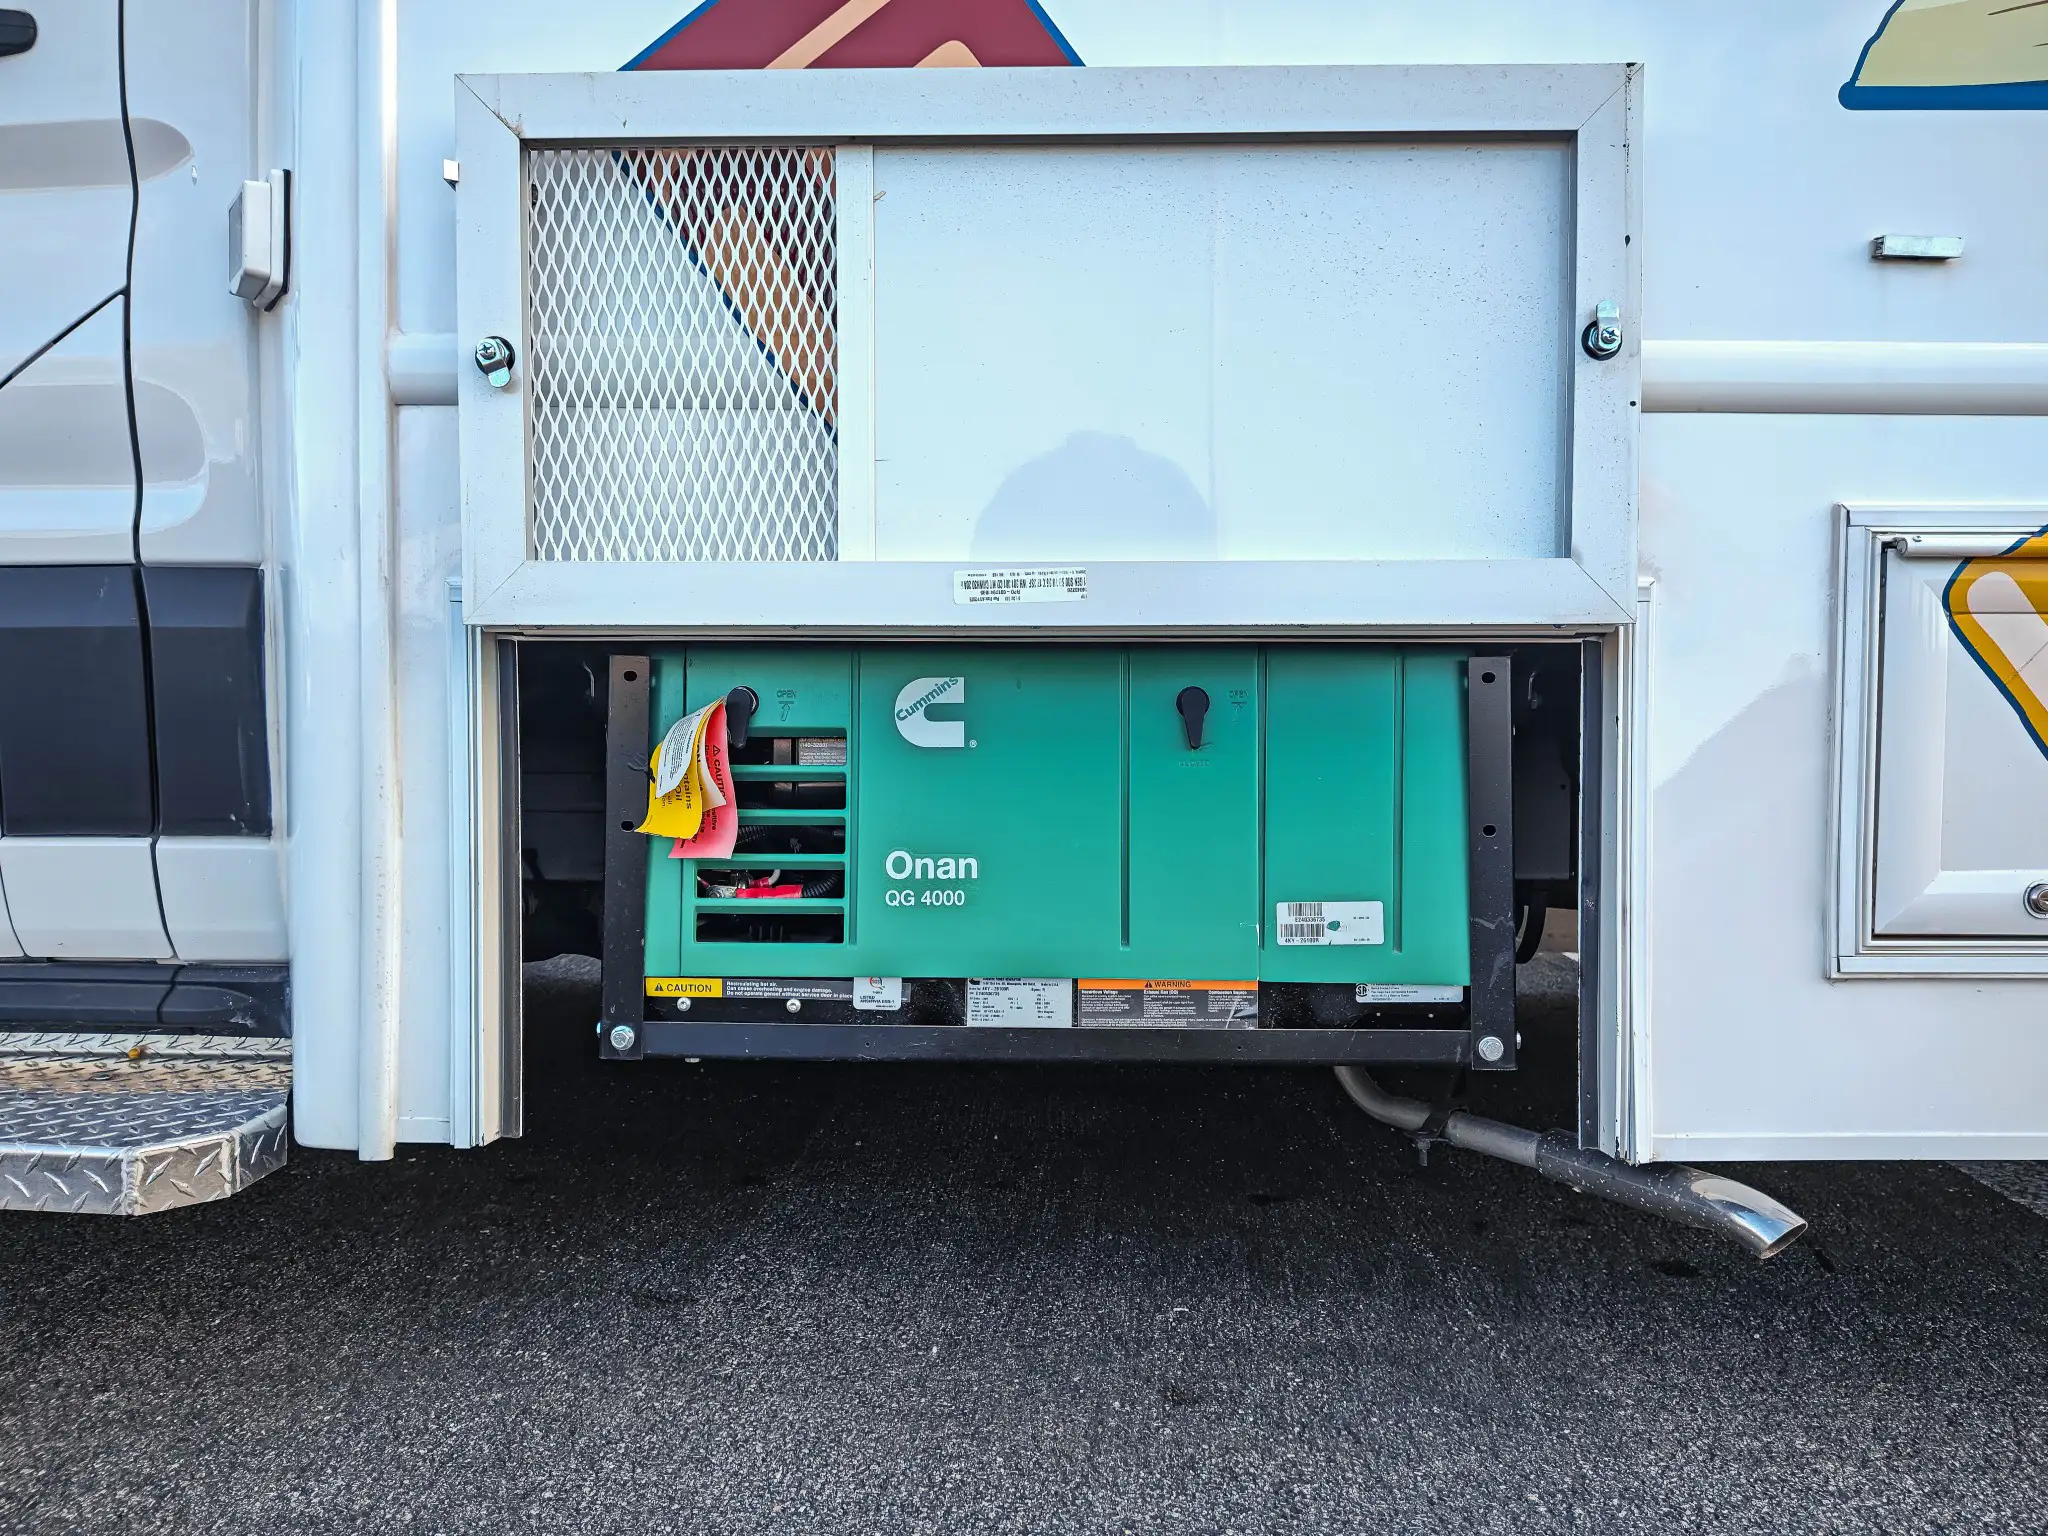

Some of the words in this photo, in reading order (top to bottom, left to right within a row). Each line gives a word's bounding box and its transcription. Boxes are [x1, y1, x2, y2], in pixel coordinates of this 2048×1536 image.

[776, 689, 797, 698] OPEN
[895, 676, 959, 722] Cummins
[714, 759, 728, 801] CAUTIO
[885, 850, 978, 880] Onan
[885, 890, 915, 907] QG
[920, 890, 965, 906] 4000
[666, 983, 712, 993] CAUTION
[1154, 980, 1192, 988] WARNING
